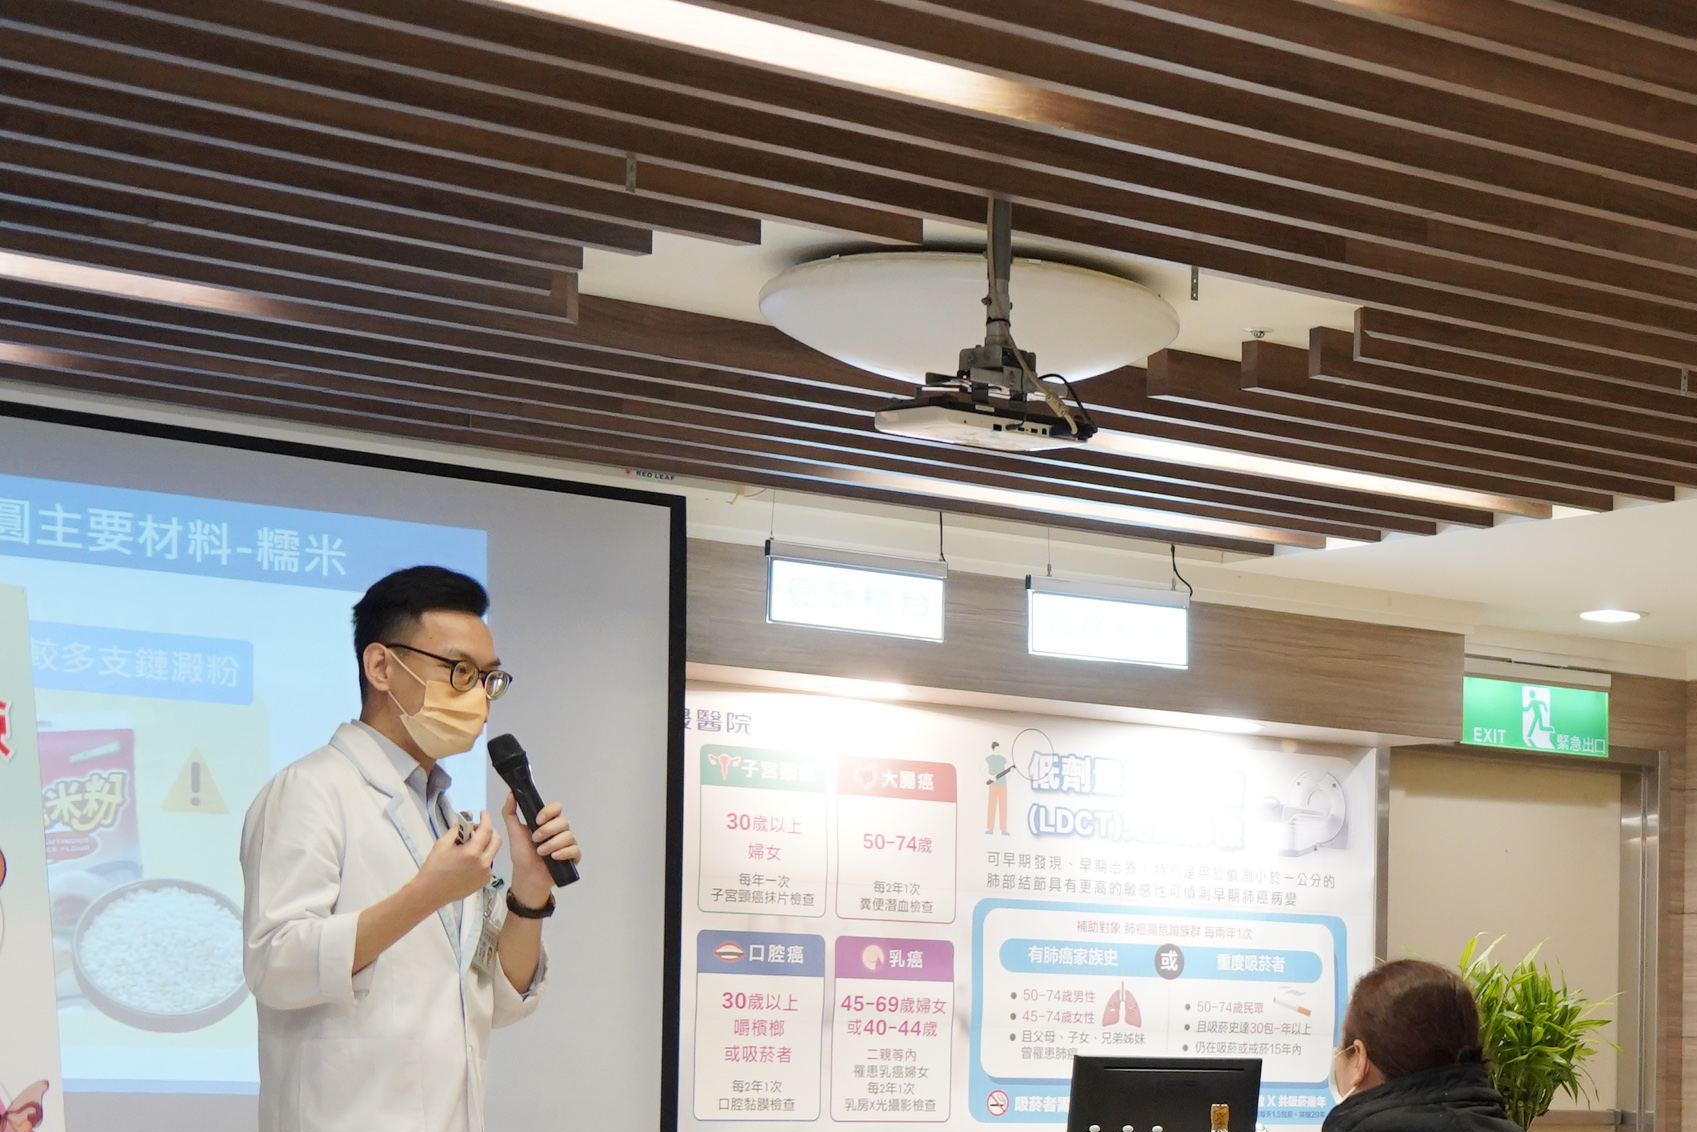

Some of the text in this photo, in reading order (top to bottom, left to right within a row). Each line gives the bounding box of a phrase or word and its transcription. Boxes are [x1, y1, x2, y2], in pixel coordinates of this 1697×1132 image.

[1473, 727, 1506, 744] EXIT
[1556, 734, 1606, 754] 緊急出口
[881, 770, 935, 791] 大腸癌
[726, 812, 803, 835] 30歲以上
[748, 843, 782, 861] 婦女
[863, 833, 932, 854] 50-74歲
[738, 872, 790, 889] 每年一次
[873, 880, 921, 896] 每2年1次
[711, 888, 815, 907] 子宮頸癌抹片檢查
[859, 897, 934, 914] 糞便潛血檢查
[749, 944, 804, 964] 口腔癌
[889, 949, 924, 969] 乳癌
[1027, 945, 1119, 967] 有肺癌家族史
[1160, 950, 1178, 972] 或
[1216, 953, 1286, 973] 重度吸菸者
[721, 992, 798, 1012] 30歲以上
[840, 995, 947, 1015] 45-69歲婦女
[1023, 989, 1096, 1004] 50-74歲男性
[1022, 1010, 1096, 1025] 45-74歲女性
[734, 1019, 785, 1037] 嚼檳榔
[846, 1019, 938, 1038] 或40-44歲
[724, 1045, 793, 1064] 或吸菸者
[866, 1048, 917, 1062] 二親等內
[853, 1064, 929, 1079] 罹患乳癌婦女
[732, 1080, 783, 1093] 每2年1次
[867, 1081, 915, 1096] 每2年1次
[718, 1097, 796, 1112] 口腔黏膜檢查
